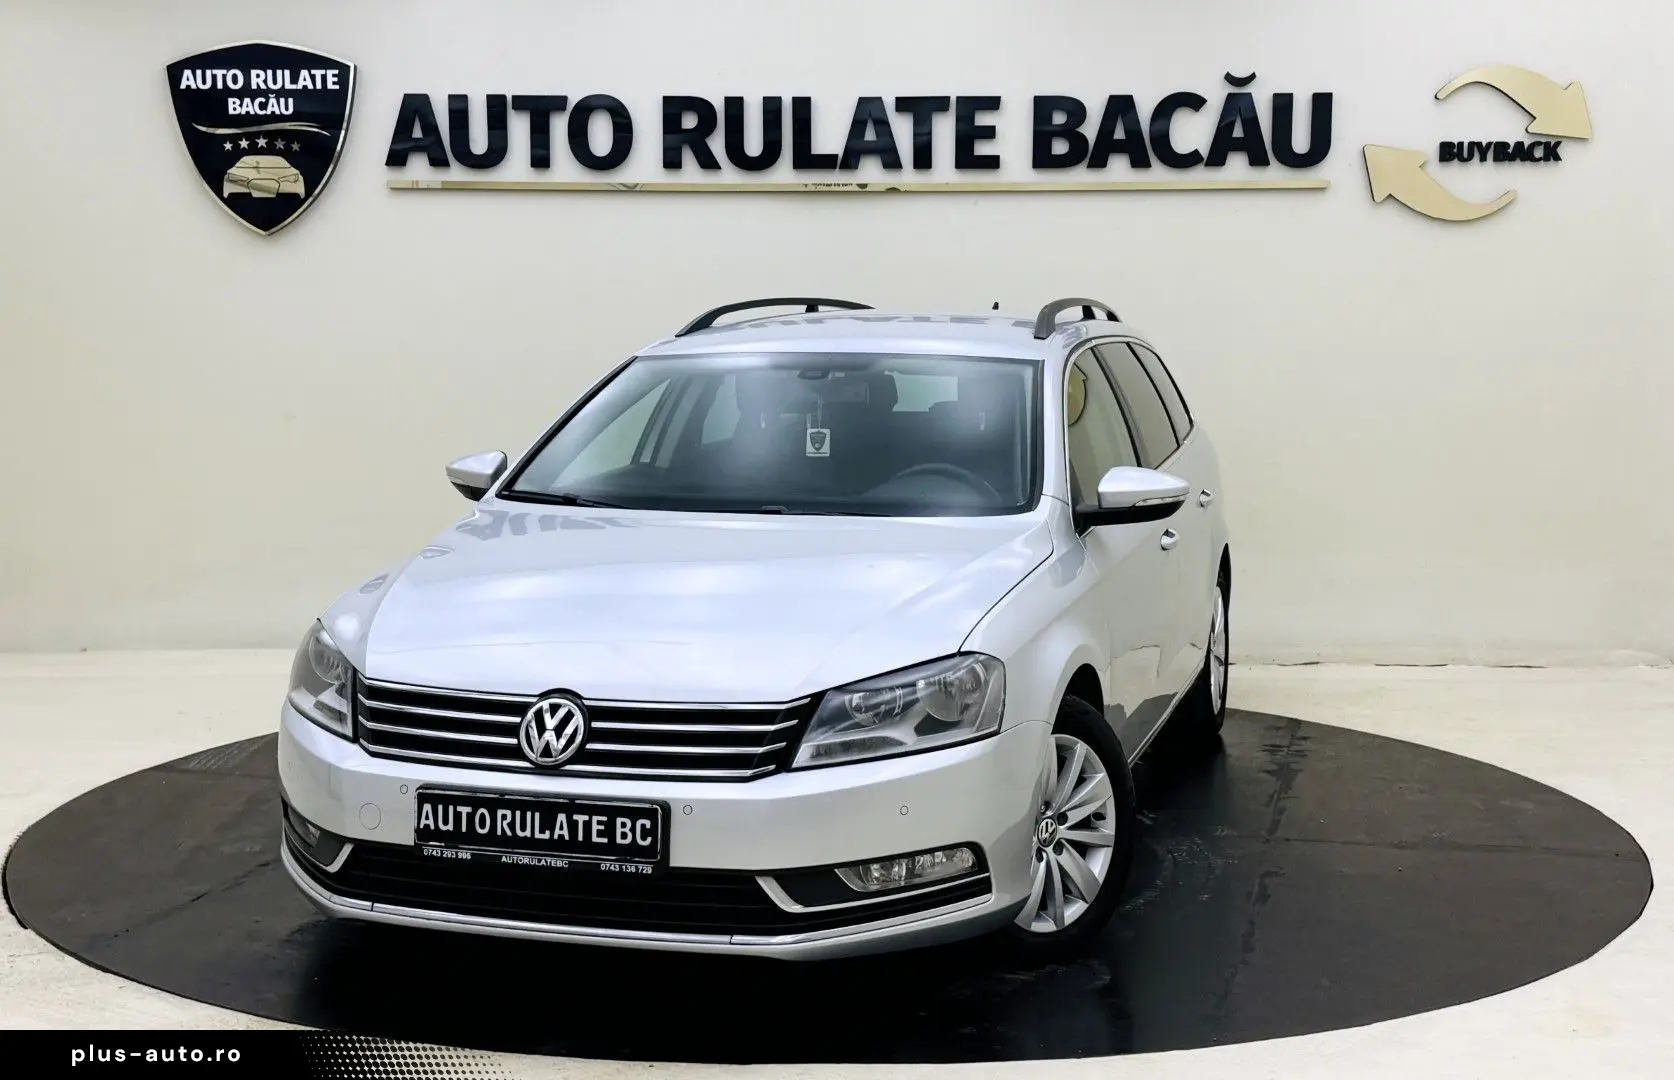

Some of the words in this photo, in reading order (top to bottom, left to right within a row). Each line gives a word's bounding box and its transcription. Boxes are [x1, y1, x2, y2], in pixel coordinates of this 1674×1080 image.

[179, 68, 244, 90] AUTO
[250, 69, 340, 90] RULATE
[227, 93, 294, 115] BACĂU
[384, 93, 634, 171] AUTO
[662, 95, 1002, 172] RULATE
[1031, 71, 1333, 169] BACĂU
[1438, 140, 1563, 163] BUYBACK
[615, 816, 652, 846] BC
[423, 848, 441, 857] 0743
[501, 855, 569, 868] AUTORULATEBC
[600, 863, 620, 872] 0743
